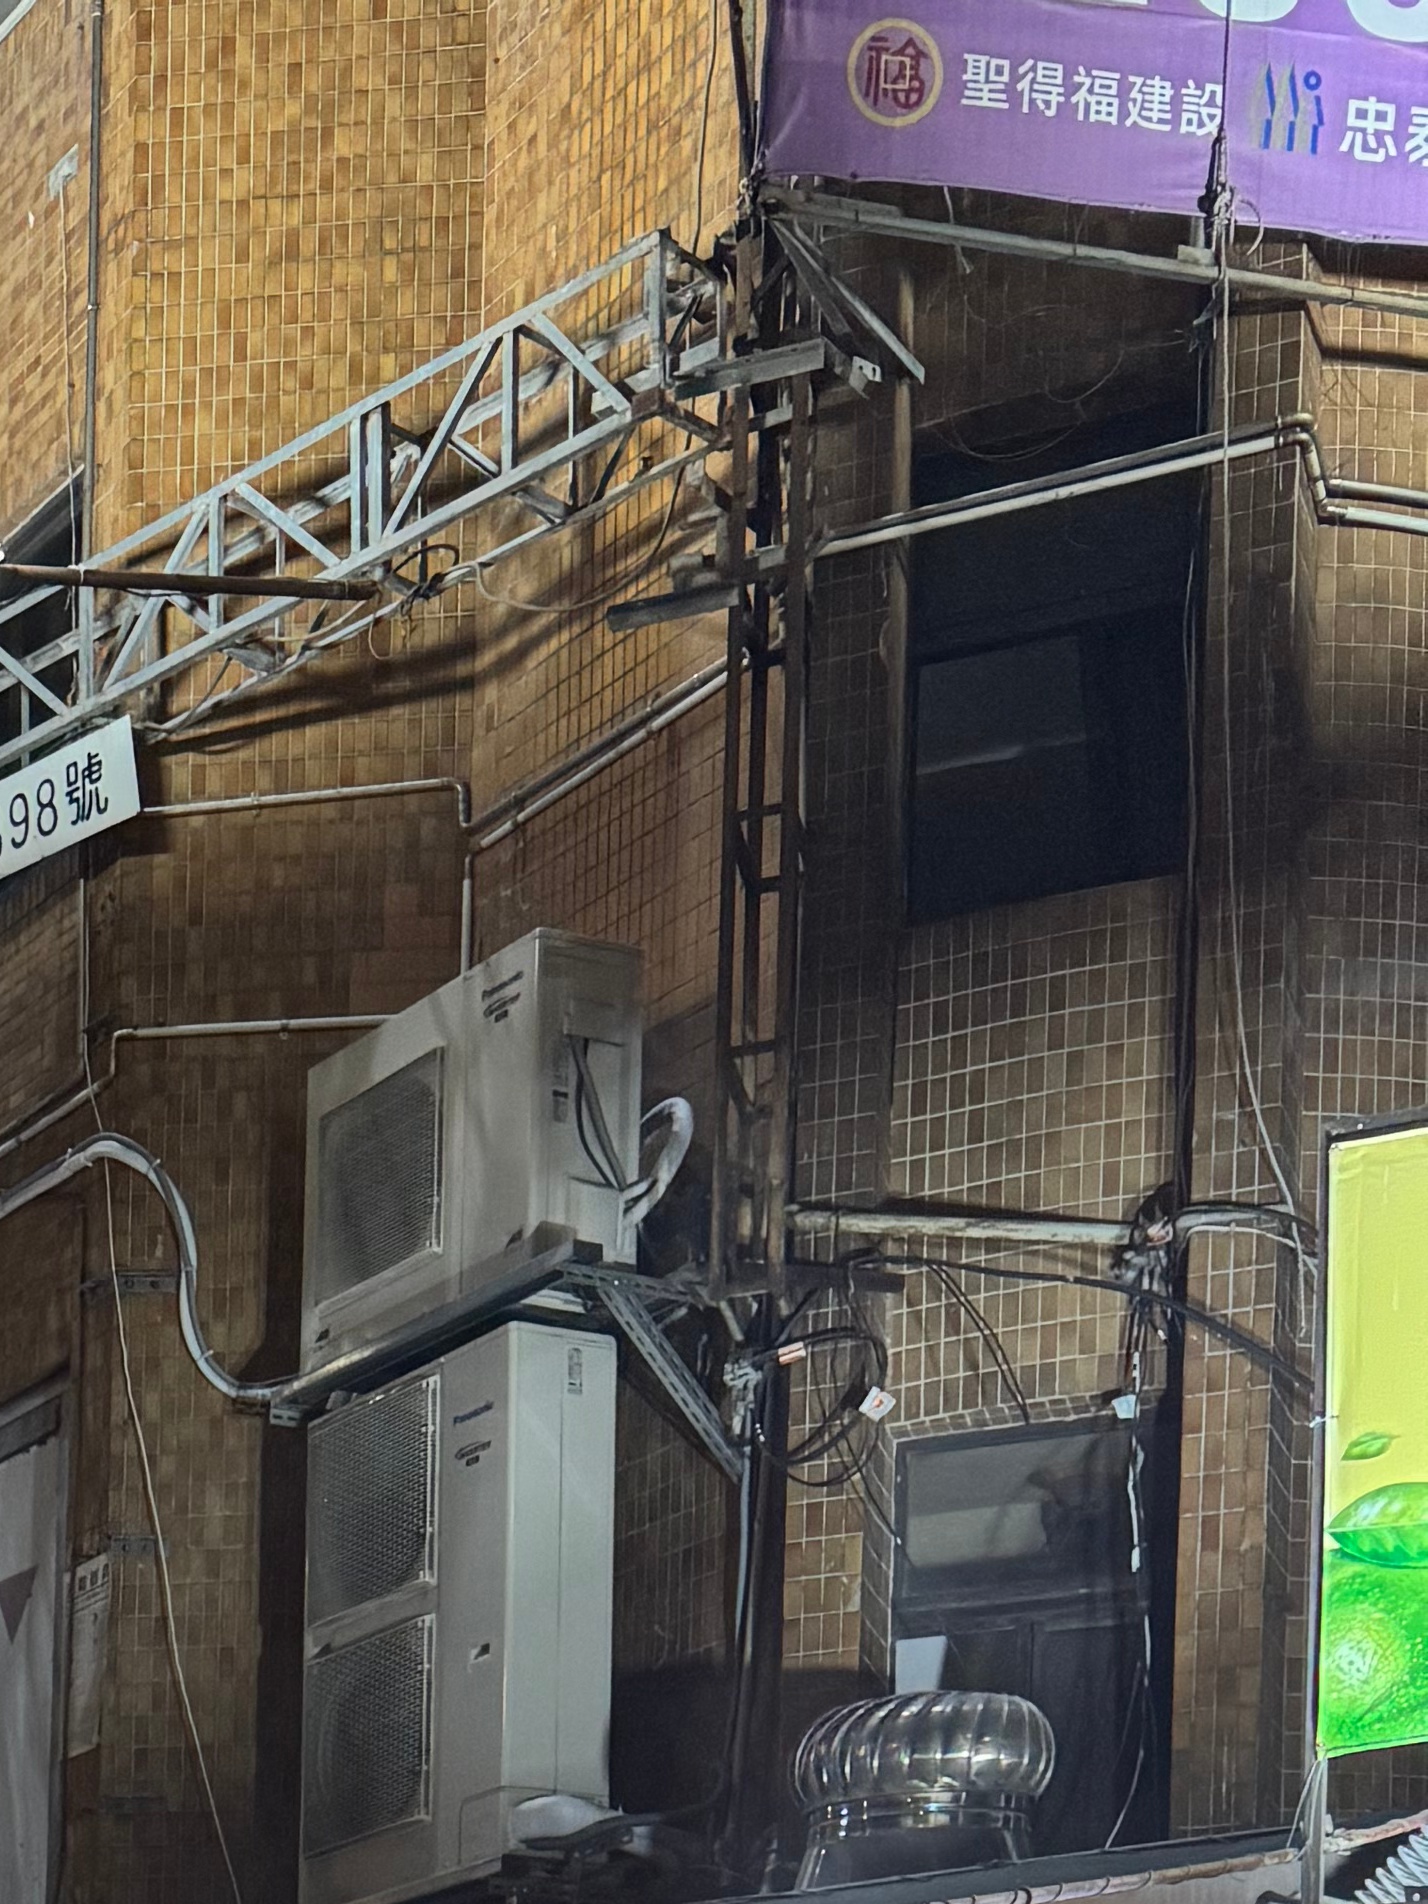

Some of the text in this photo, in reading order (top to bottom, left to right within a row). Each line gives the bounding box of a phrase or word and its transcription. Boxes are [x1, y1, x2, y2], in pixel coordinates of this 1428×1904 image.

[960, 52, 1225, 138] 聖得福建設
